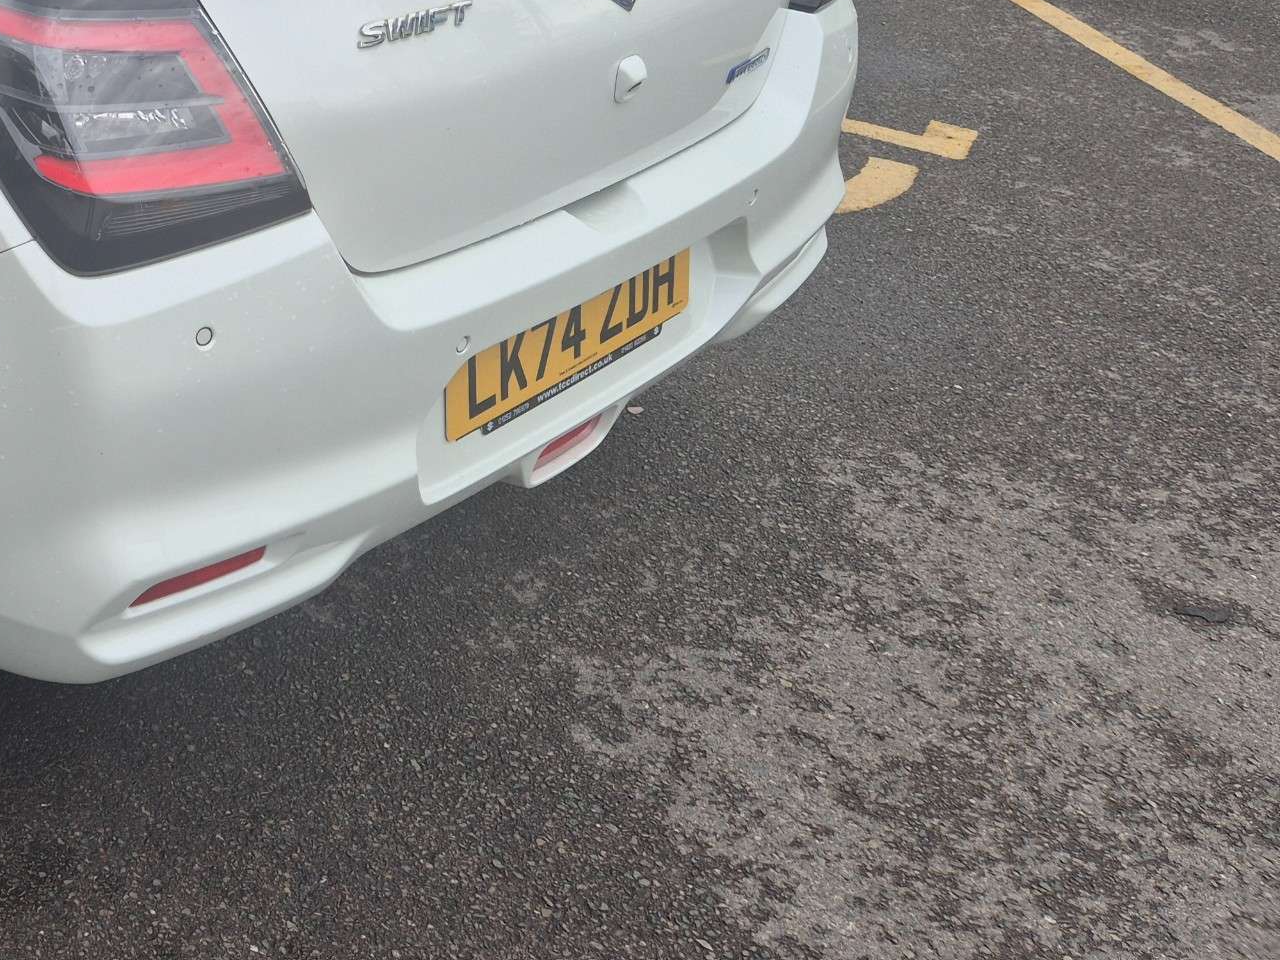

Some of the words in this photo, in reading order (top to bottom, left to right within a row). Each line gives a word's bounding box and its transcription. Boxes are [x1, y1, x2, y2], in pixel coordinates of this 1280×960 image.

[356, 0, 473, 49] SWIFT
[467, 303, 587, 420] LK74
[599, 255, 676, 345] ZDH
